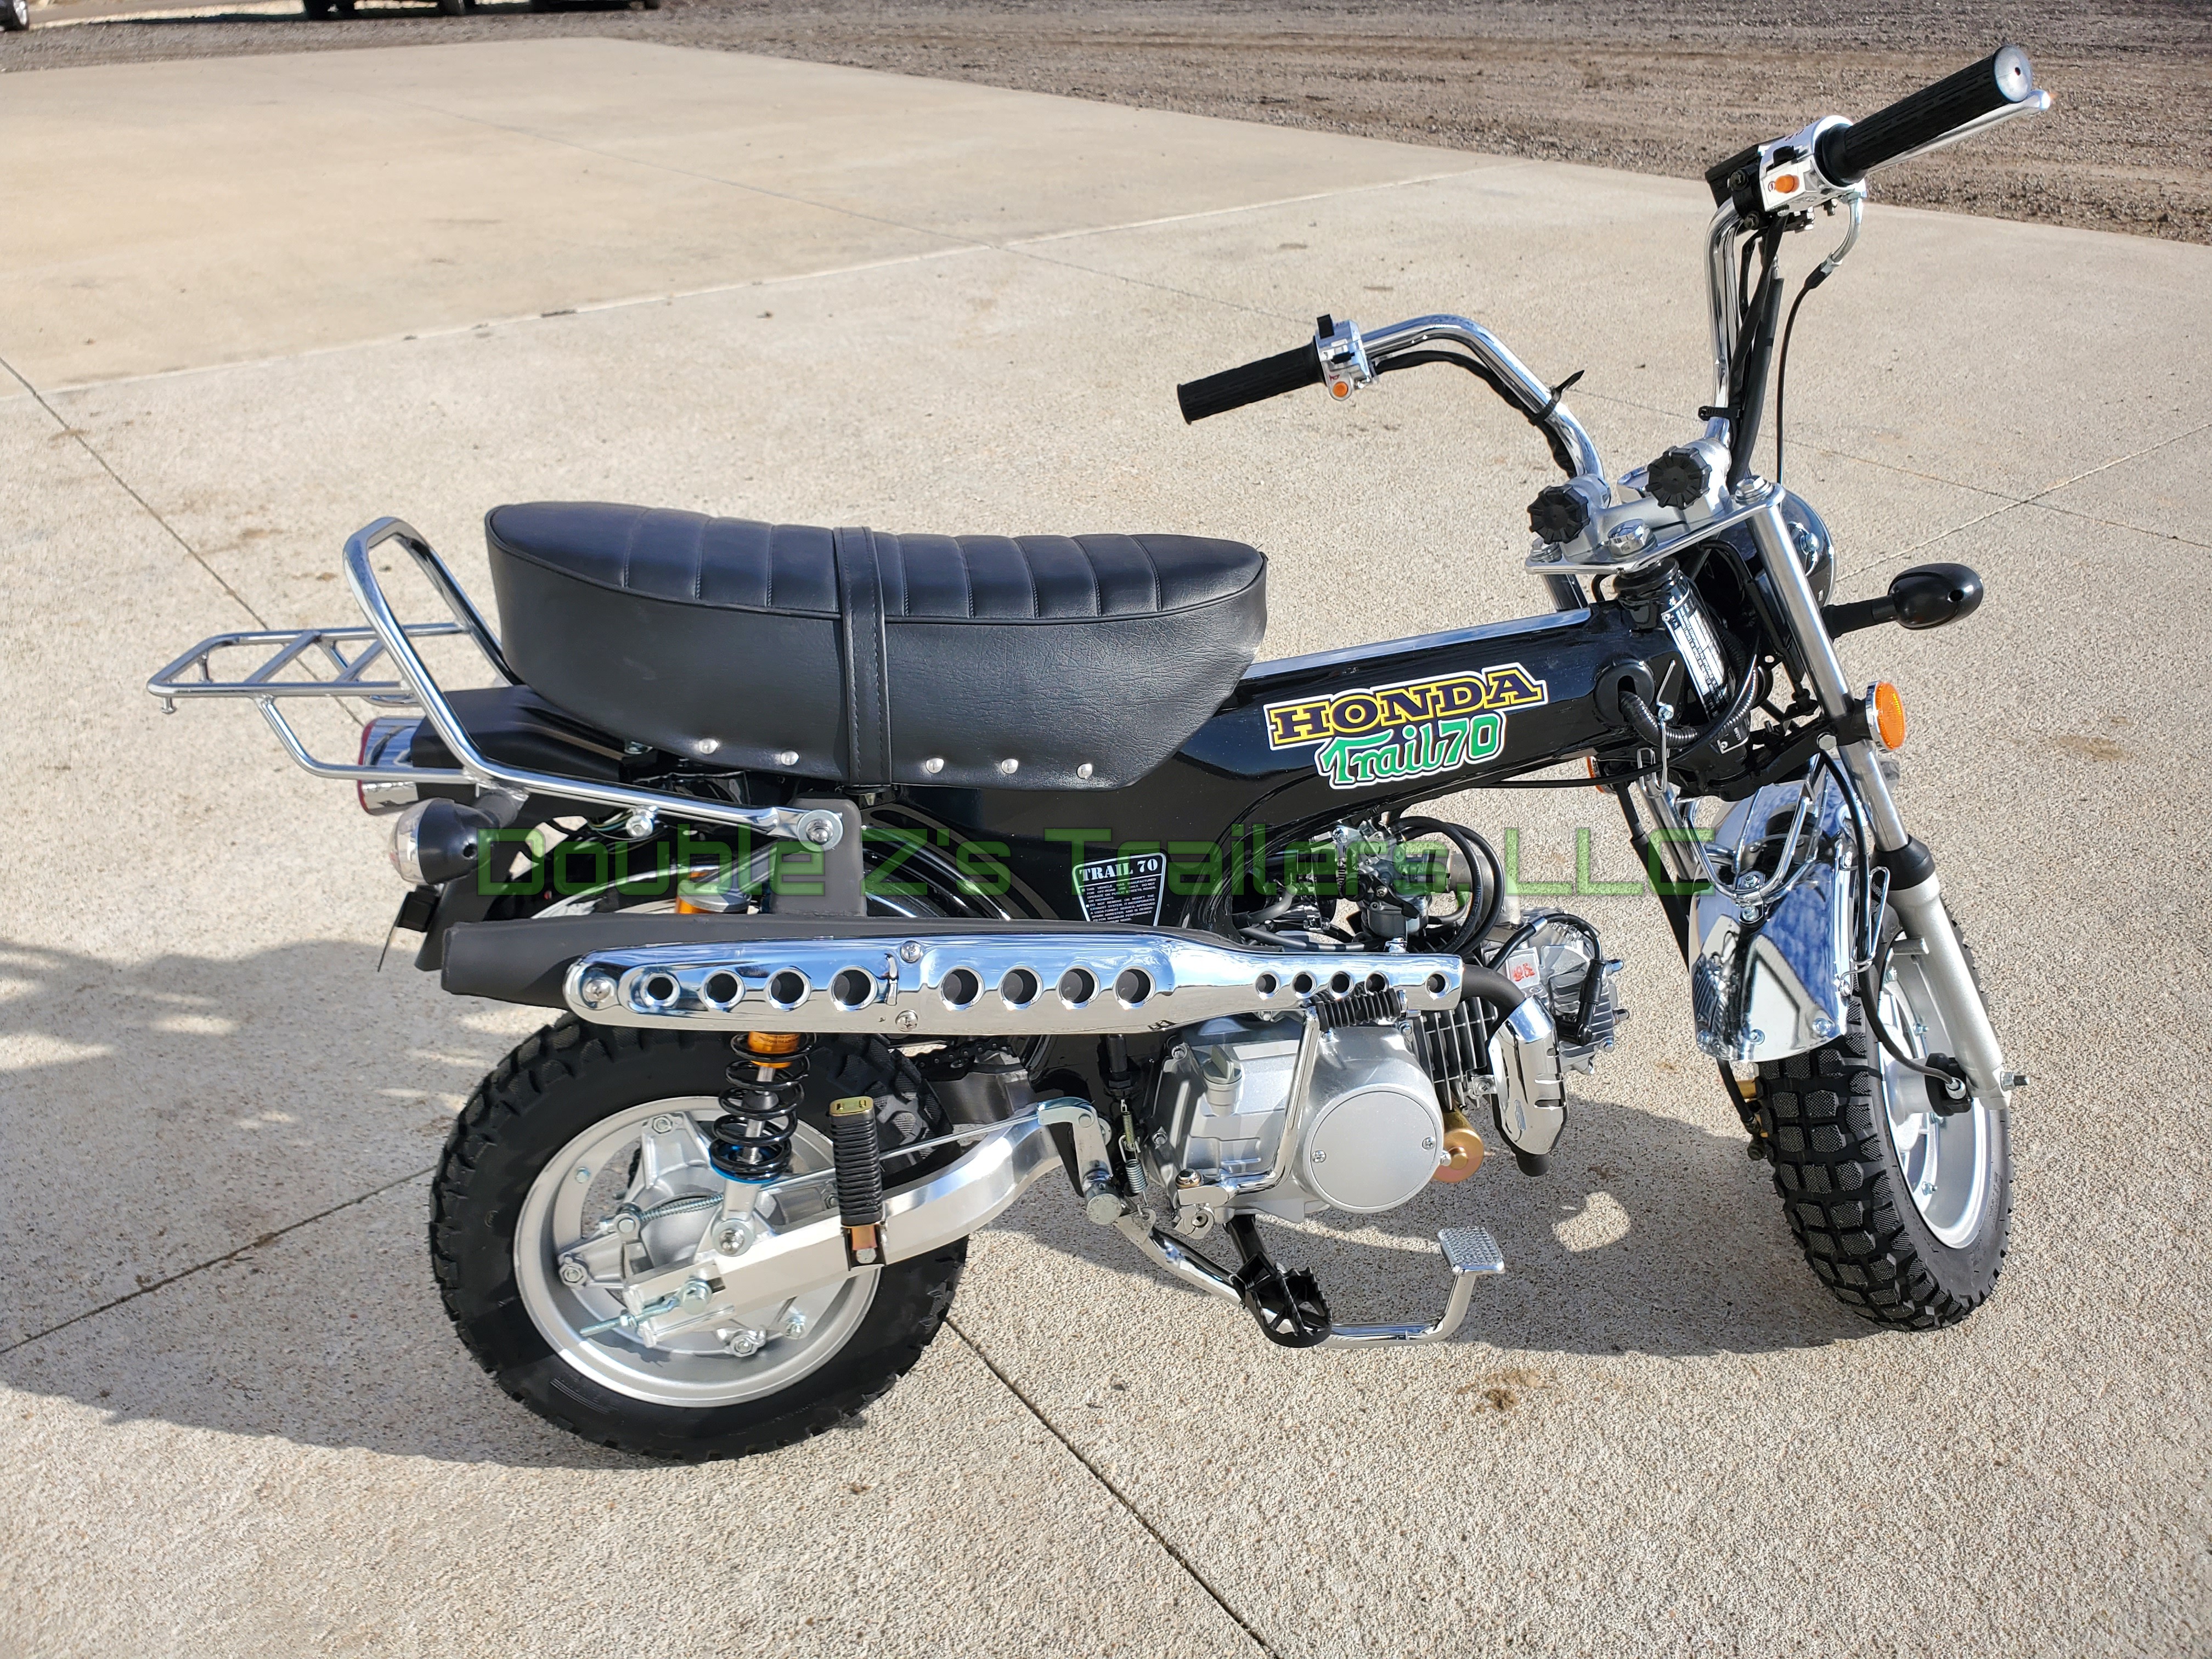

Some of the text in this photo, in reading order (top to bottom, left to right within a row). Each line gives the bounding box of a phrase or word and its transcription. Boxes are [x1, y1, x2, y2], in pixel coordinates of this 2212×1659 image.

[1268, 668, 1544, 745] HONDA
[1079, 859, 1158, 882] TRAIL 70
